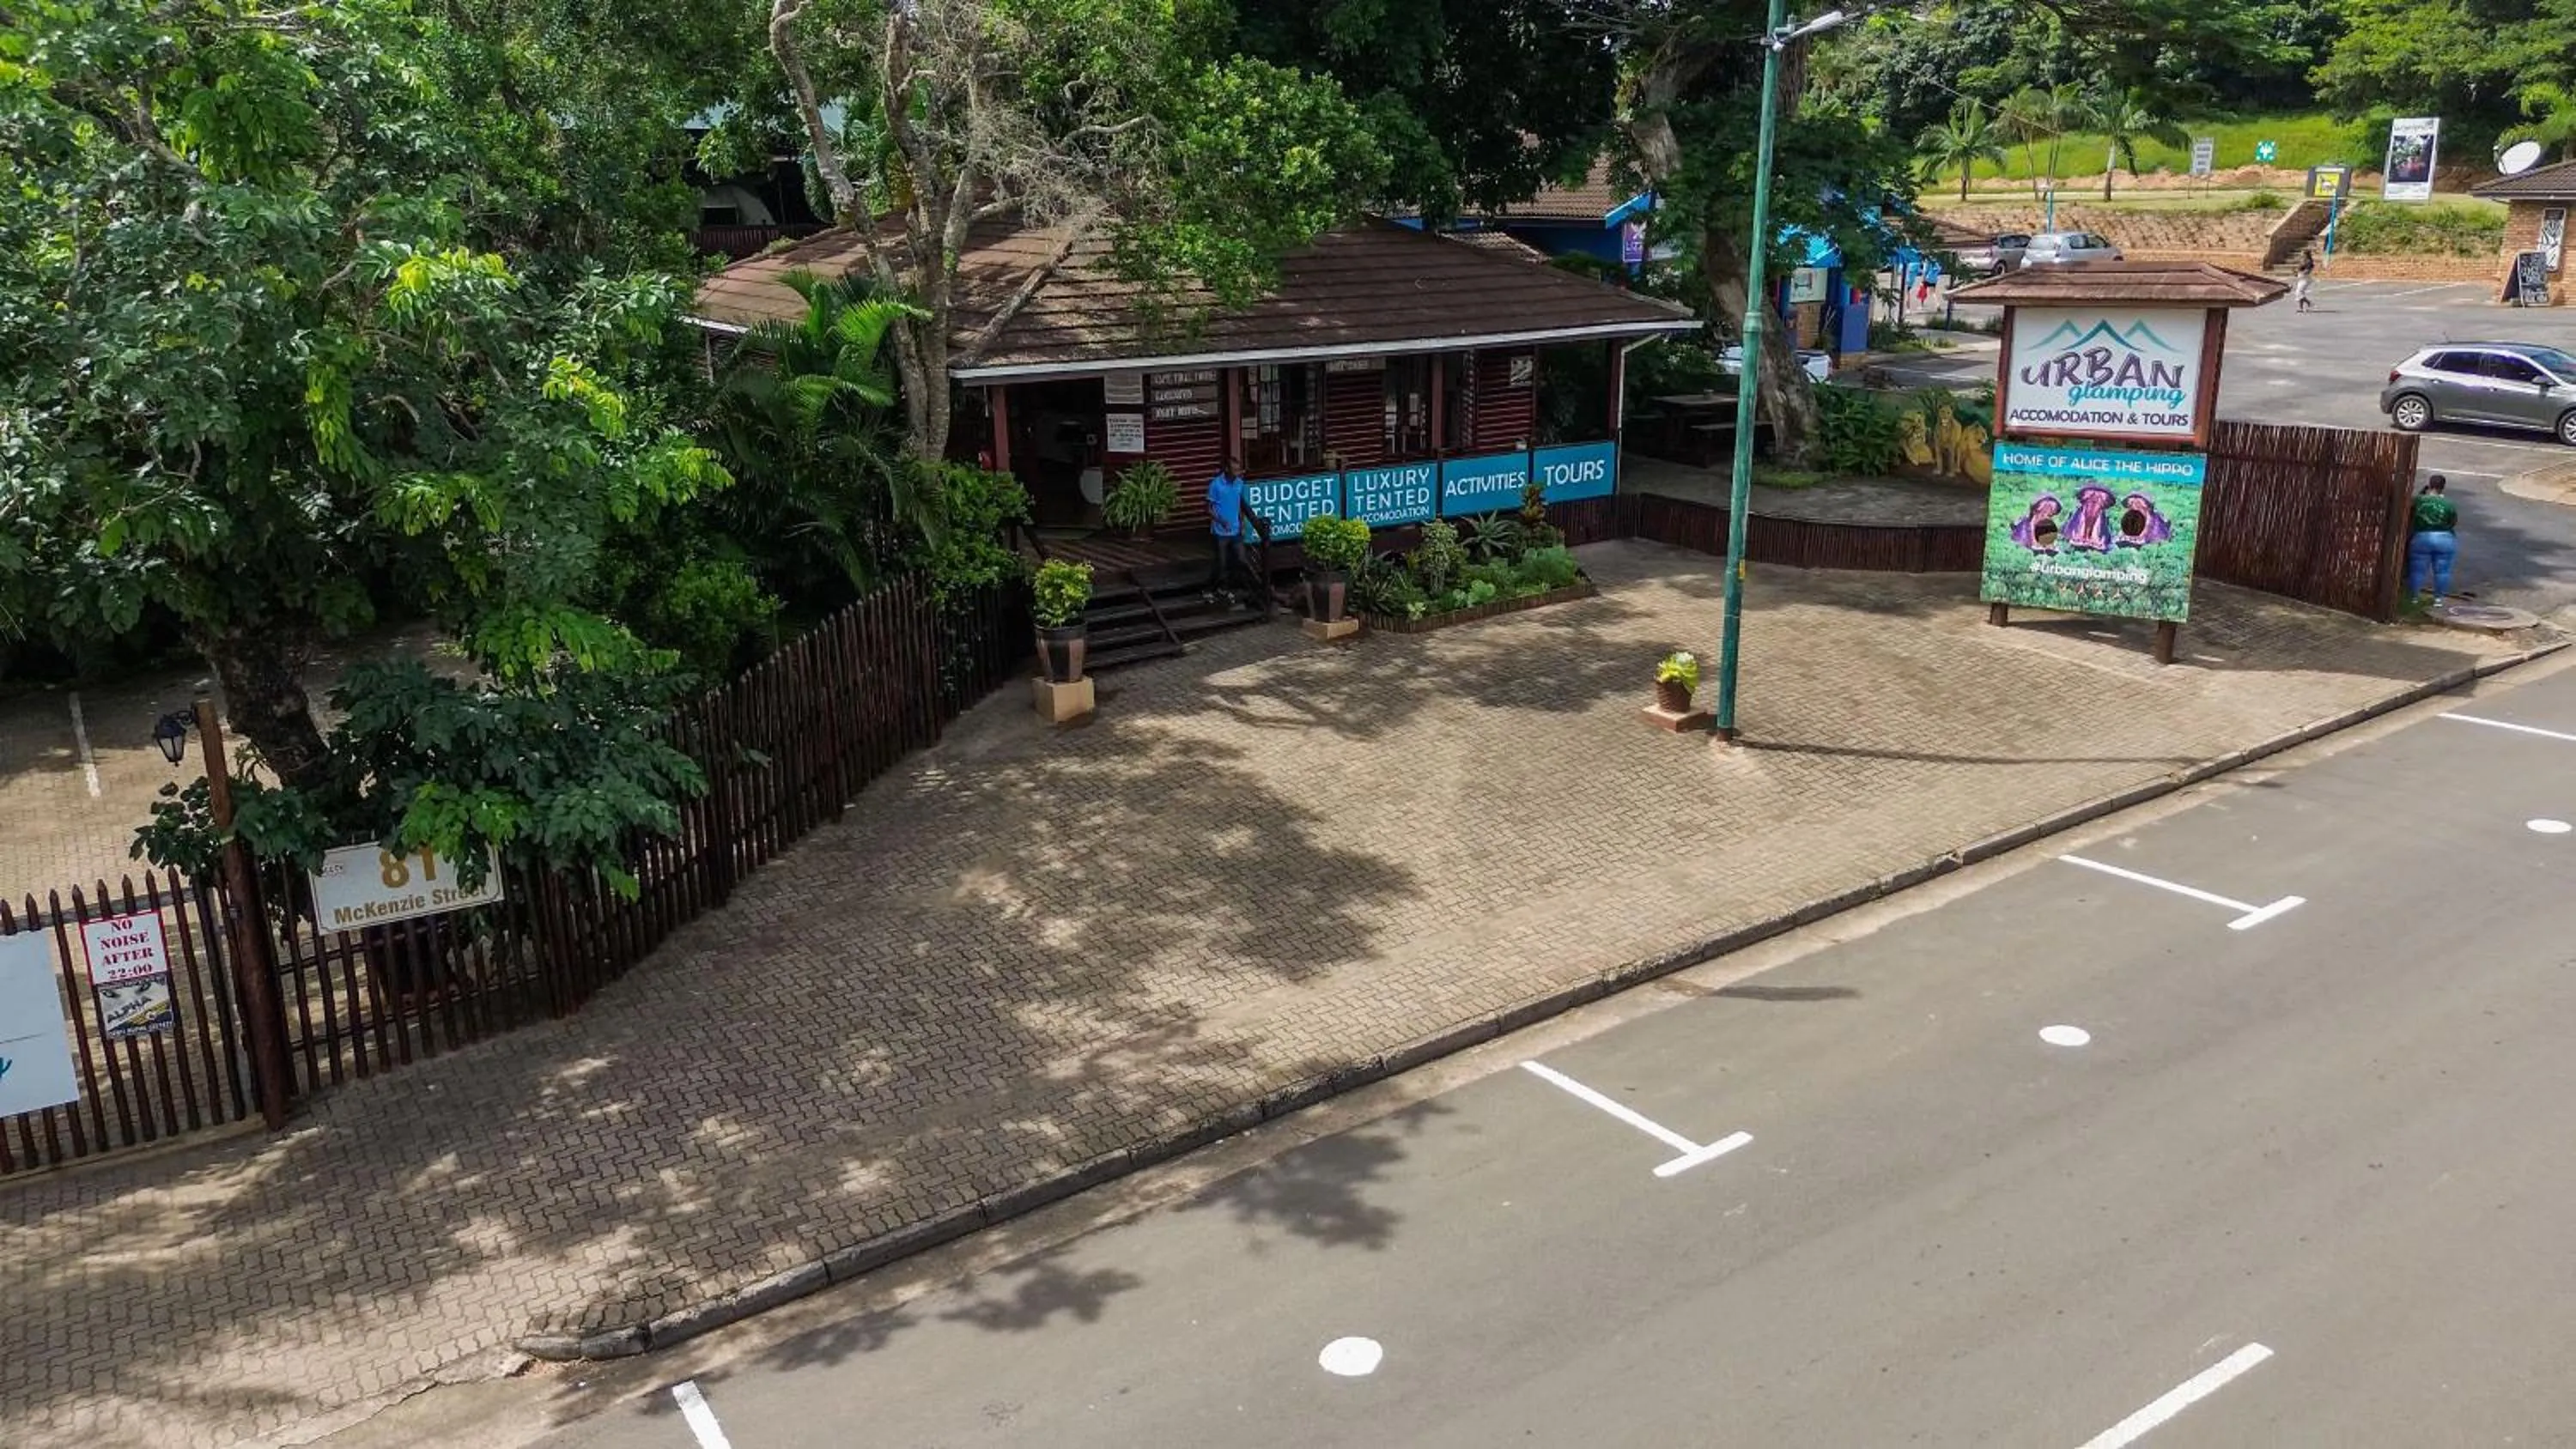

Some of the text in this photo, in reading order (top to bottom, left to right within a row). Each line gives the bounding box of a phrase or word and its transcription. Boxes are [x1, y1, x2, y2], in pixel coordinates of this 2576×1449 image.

[2068, 383, 2186, 409] glamping
[2010, 409, 2189, 427] ACCOMODATION & TOURS
[1543, 459, 1606, 488] TOURS
[2002, 453, 2194, 476] HOME OF ALICE THE HIPPO
[1249, 478, 1334, 505] BUDGET
[1353, 467, 1430, 493] LUXURY
[1445, 471, 1526, 498] ACTIVITIES
[1354, 487, 1430, 512] TENTED
[2029, 561, 2148, 585] #urbanglamping
[334, 894, 426, 925] McKenzie
[111, 919, 133, 933] NO
[100, 931, 150, 950] NOISE
[102, 947, 155, 967] AFTER
[107, 963, 153, 979] 22:00
[106, 996, 153, 1023] ALPHA
